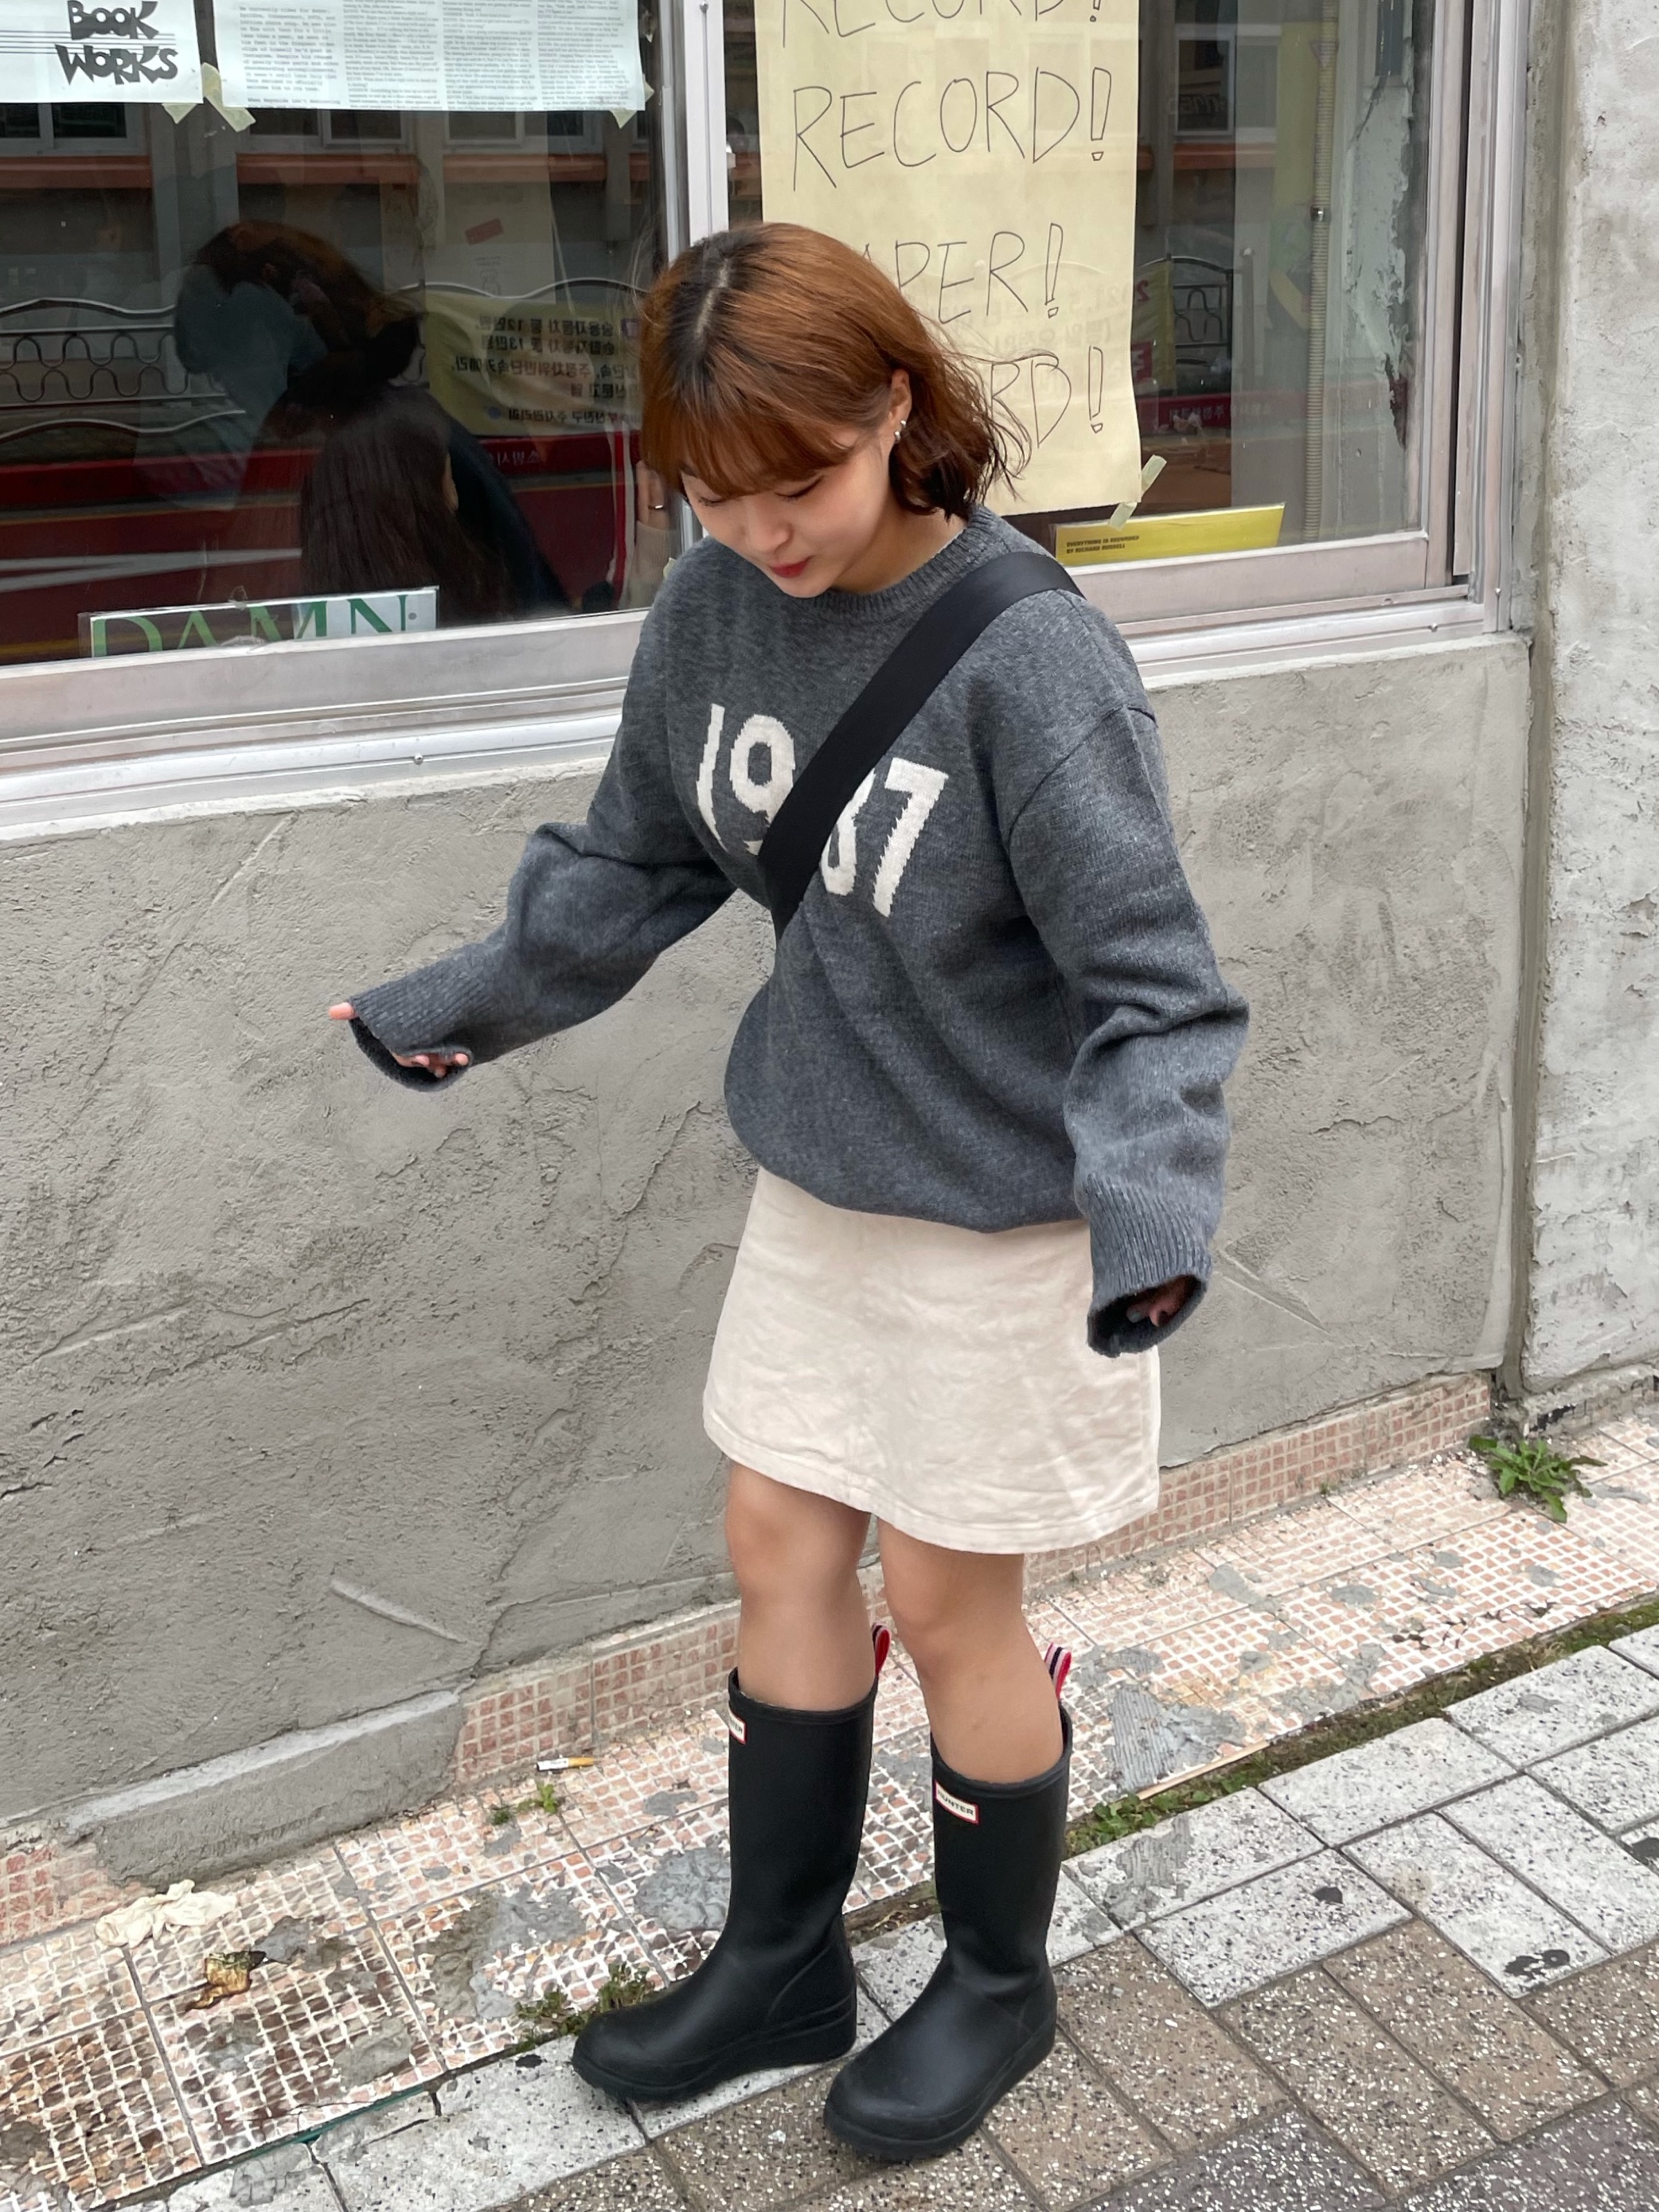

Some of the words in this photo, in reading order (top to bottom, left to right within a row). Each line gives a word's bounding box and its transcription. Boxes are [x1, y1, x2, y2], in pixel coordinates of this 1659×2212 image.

[67, 0, 159, 41] BOOK
[54, 44, 178, 86] WORKS
[793, 66, 1112, 192] RECORD!
[862, 223, 1064, 325] PER!
